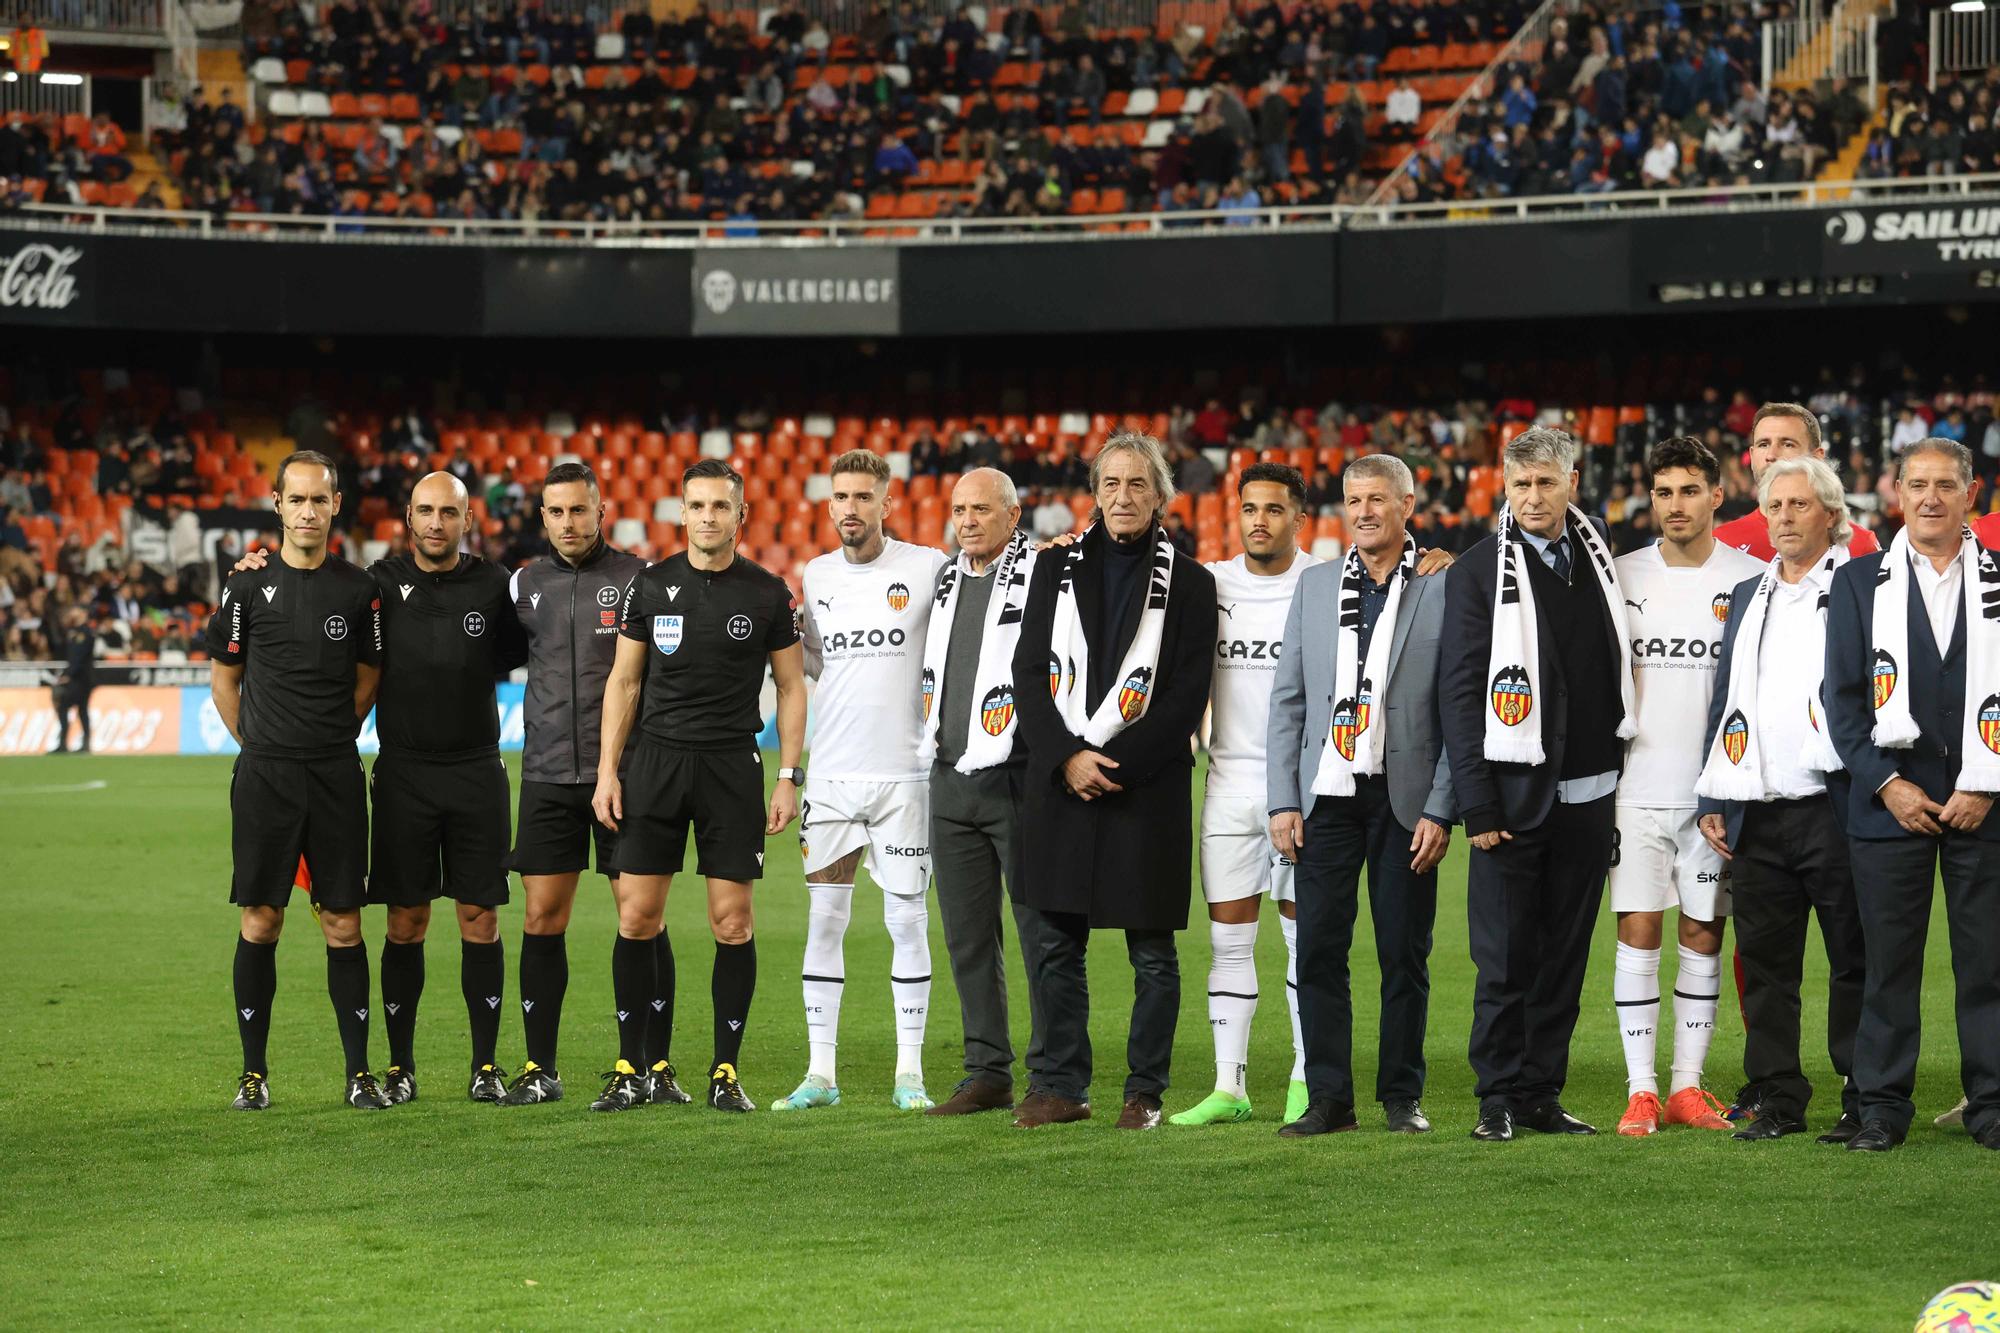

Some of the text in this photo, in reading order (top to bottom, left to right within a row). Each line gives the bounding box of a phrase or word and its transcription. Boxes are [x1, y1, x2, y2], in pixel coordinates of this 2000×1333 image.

[656, 617, 680, 627] FIFA
[823, 628, 906, 653] CAZOO
[901, 1007, 924, 1015] VFC
[1685, 1021, 1712, 1029] VFC
[1627, 1027, 1652, 1037] VFC
